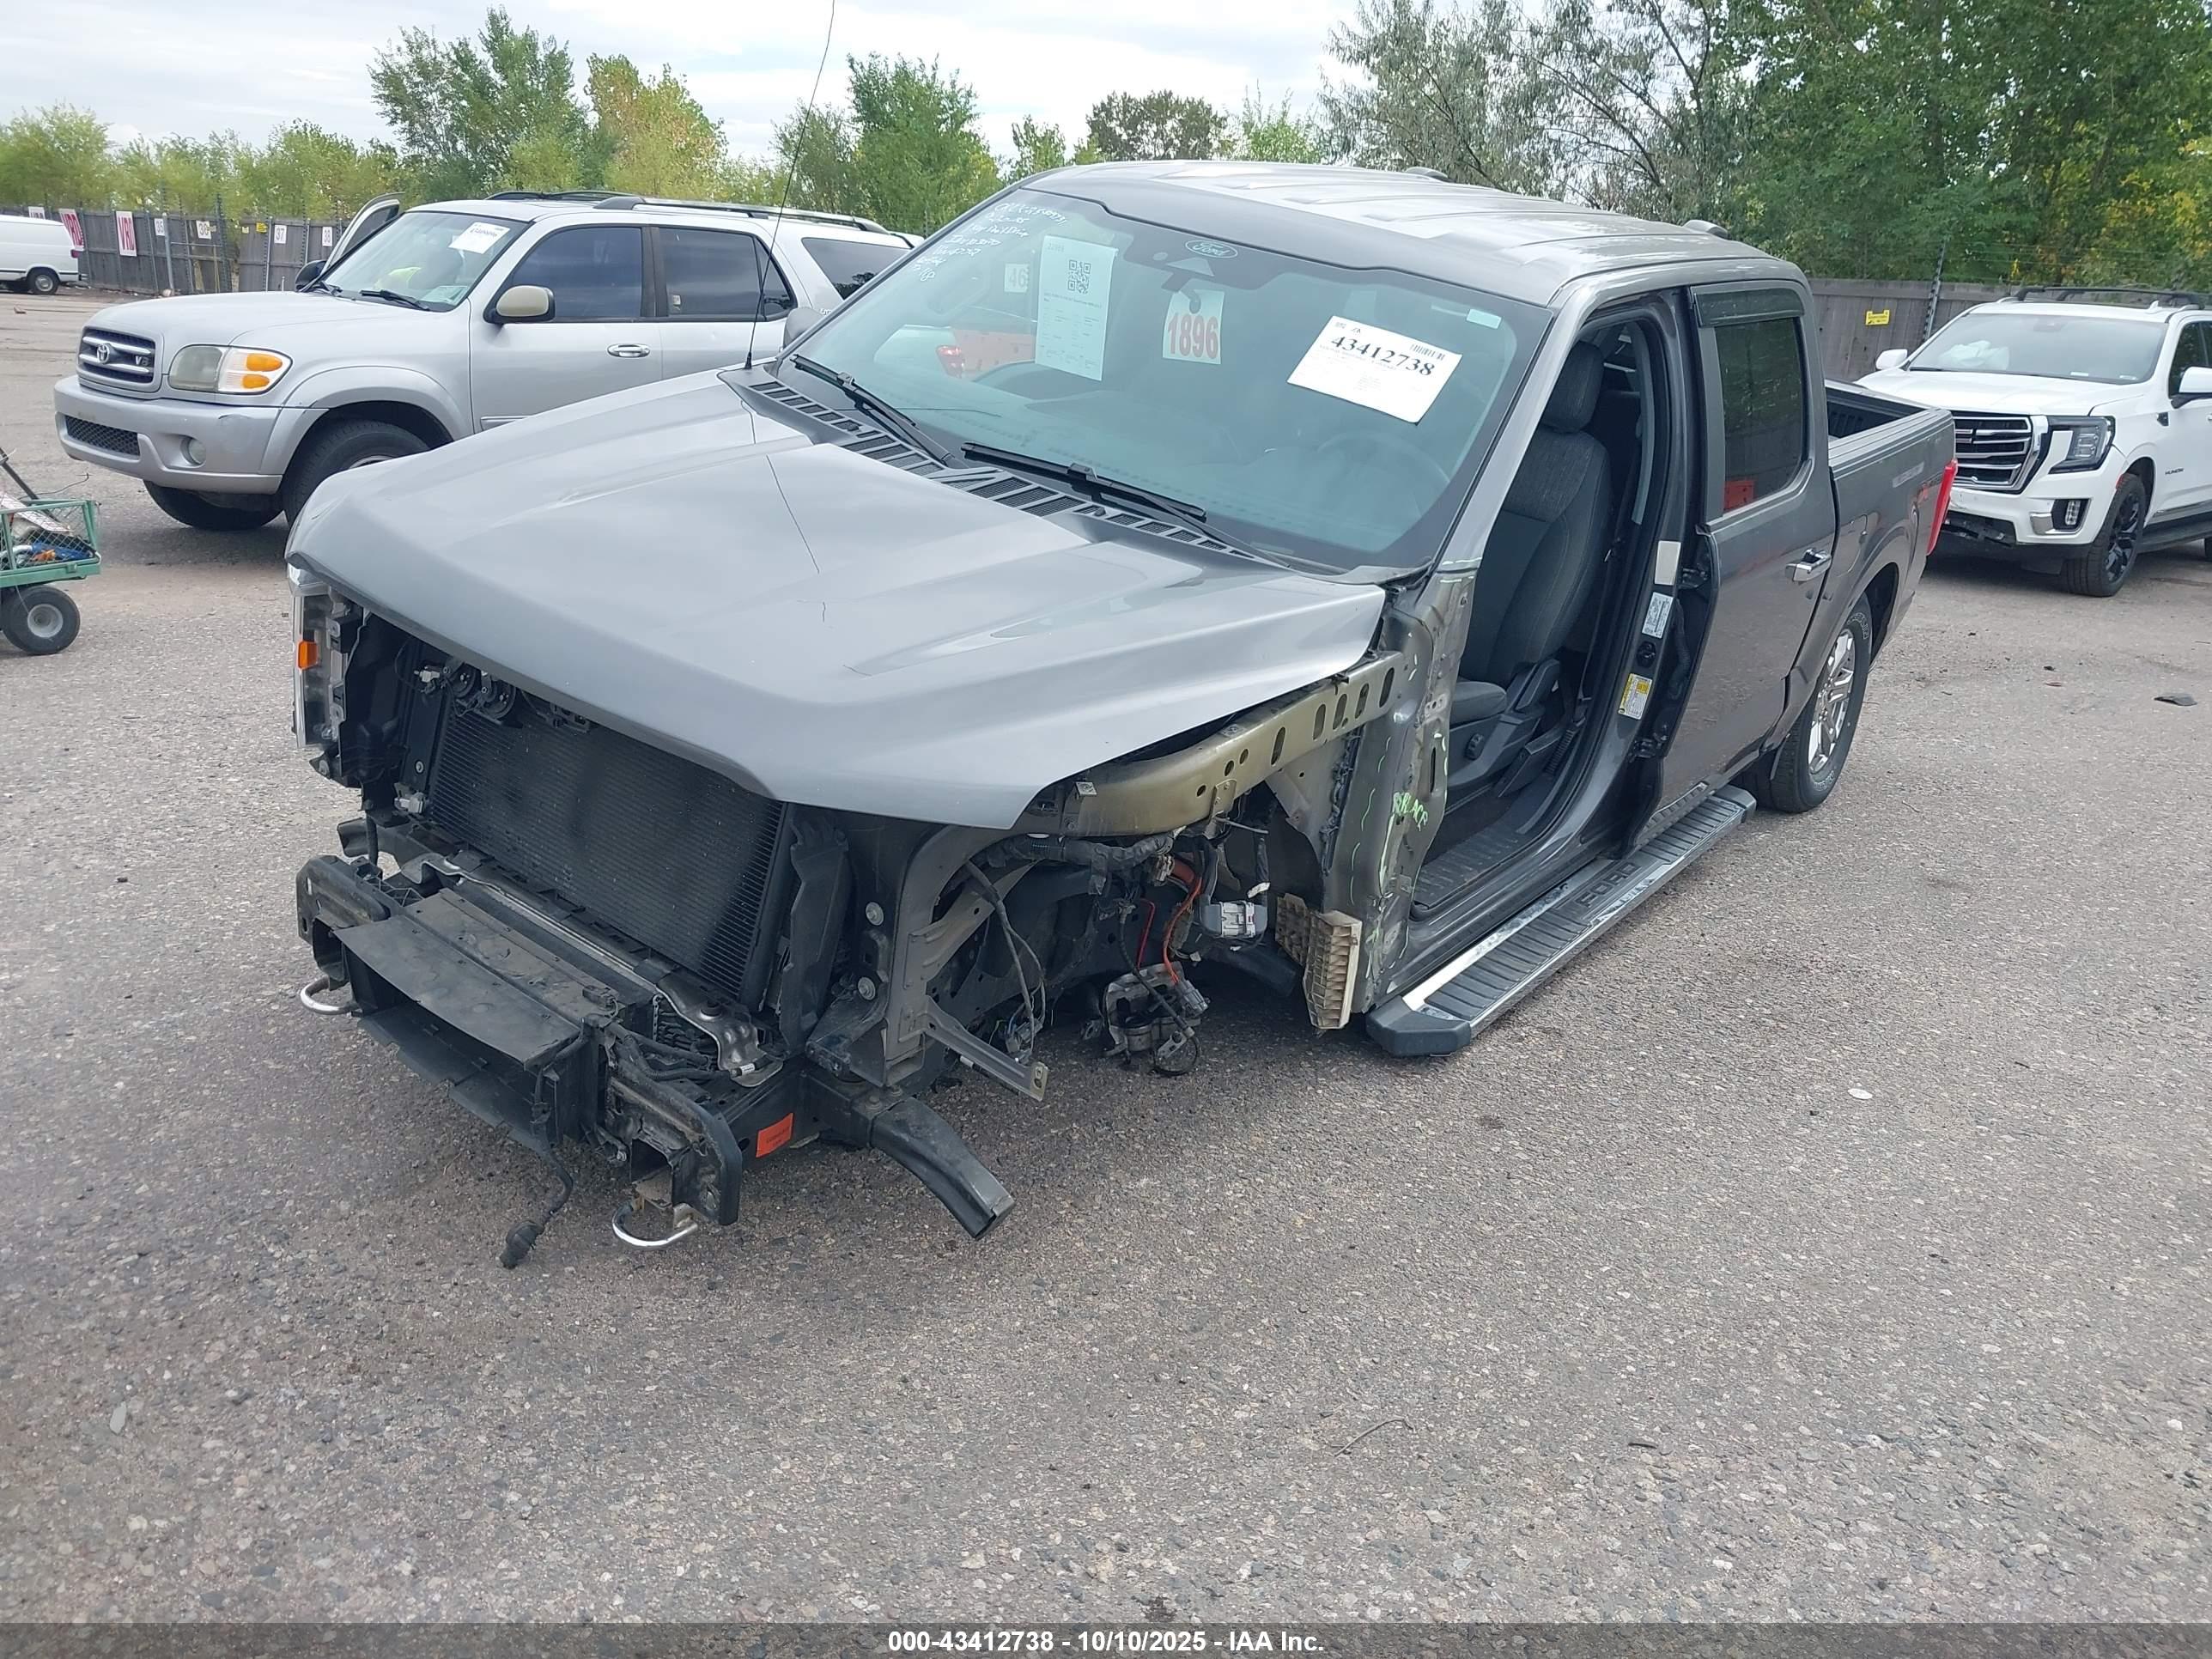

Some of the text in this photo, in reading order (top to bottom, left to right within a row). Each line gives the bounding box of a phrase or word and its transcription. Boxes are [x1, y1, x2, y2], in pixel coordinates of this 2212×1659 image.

[276, 227, 285, 241] 37
[1193, 243, 1231, 256] Ford
[1168, 312, 1219, 360] 1896
[1331, 336, 1436, 376] 43412738
